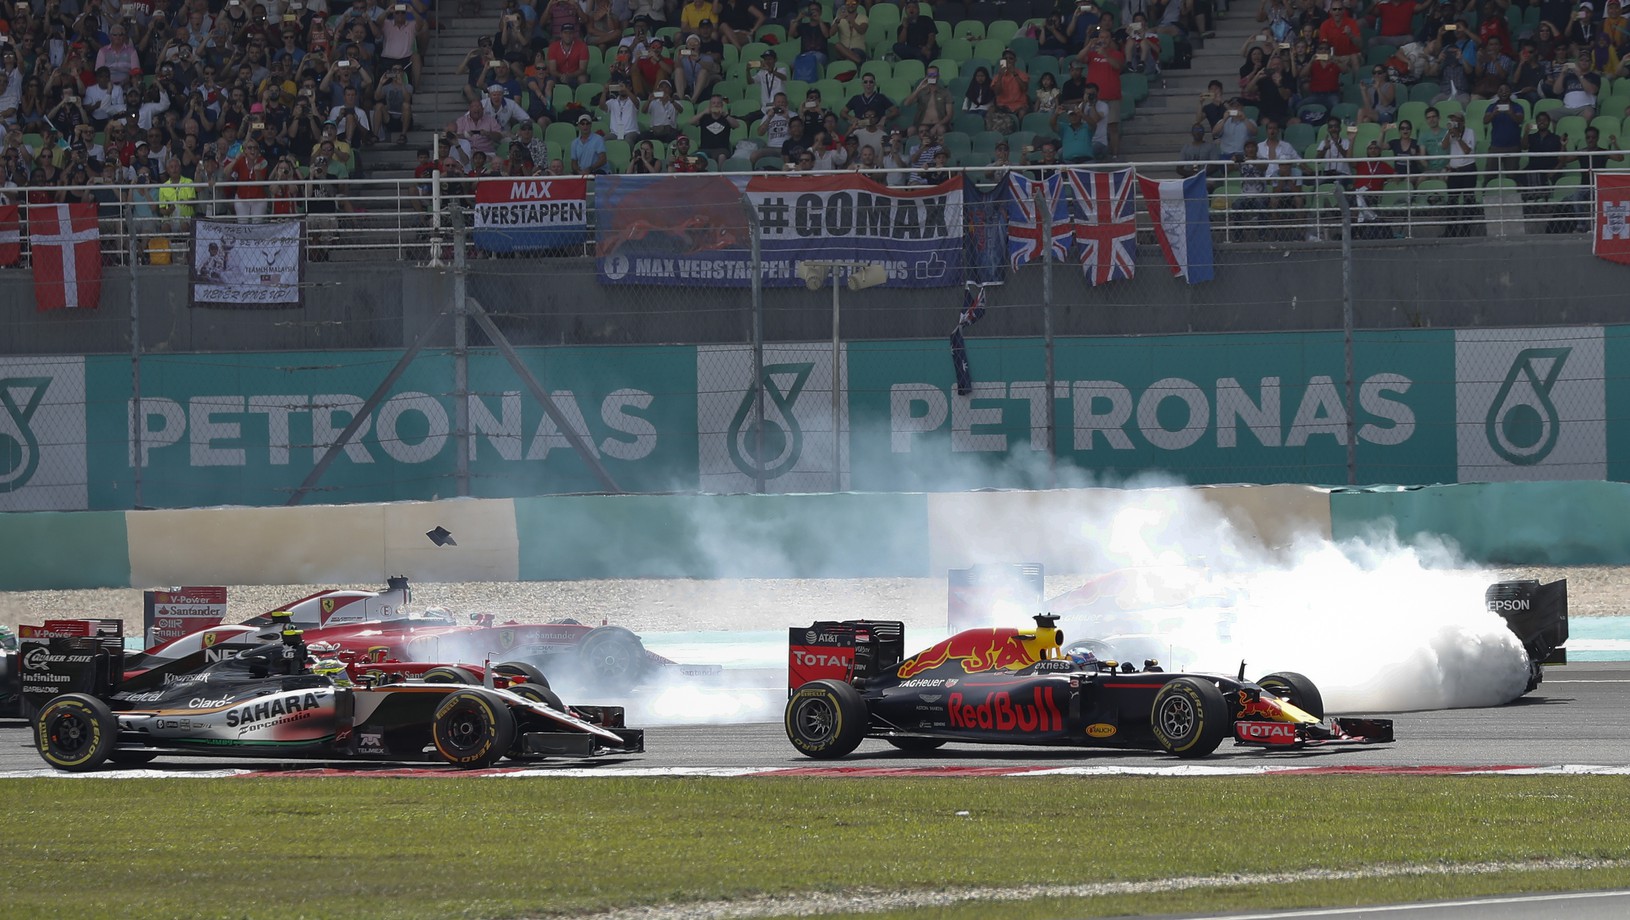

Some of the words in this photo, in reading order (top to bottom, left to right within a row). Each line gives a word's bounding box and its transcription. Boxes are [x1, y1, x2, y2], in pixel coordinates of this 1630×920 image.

[510, 181, 552, 200] MAX
[480, 202, 583, 225] VERSTAPPEN
[758, 191, 949, 239] #GOMAX
[635, 258, 676, 277] MAX
[678, 259, 790, 280] VERSTAPEN
[890, 372, 1416, 453] PETRONAS
[128, 388, 658, 467] PETRONAS
[170, 595, 210, 604] V-Power
[1488, 599, 1531, 611] EPSON
[170, 605, 221, 616] Santander
[34, 629, 72, 638] V-Power
[818, 633, 840, 643] AT&T
[31, 653, 66, 663] QUAKER
[66, 655, 94, 663] STATE
[1034, 660, 1071, 670] exness
[23, 672, 71, 682] infinitum
[188, 697, 226, 709] Claro
[226, 692, 320, 728] SAHARA
[1237, 723, 1294, 737] TOTAL
